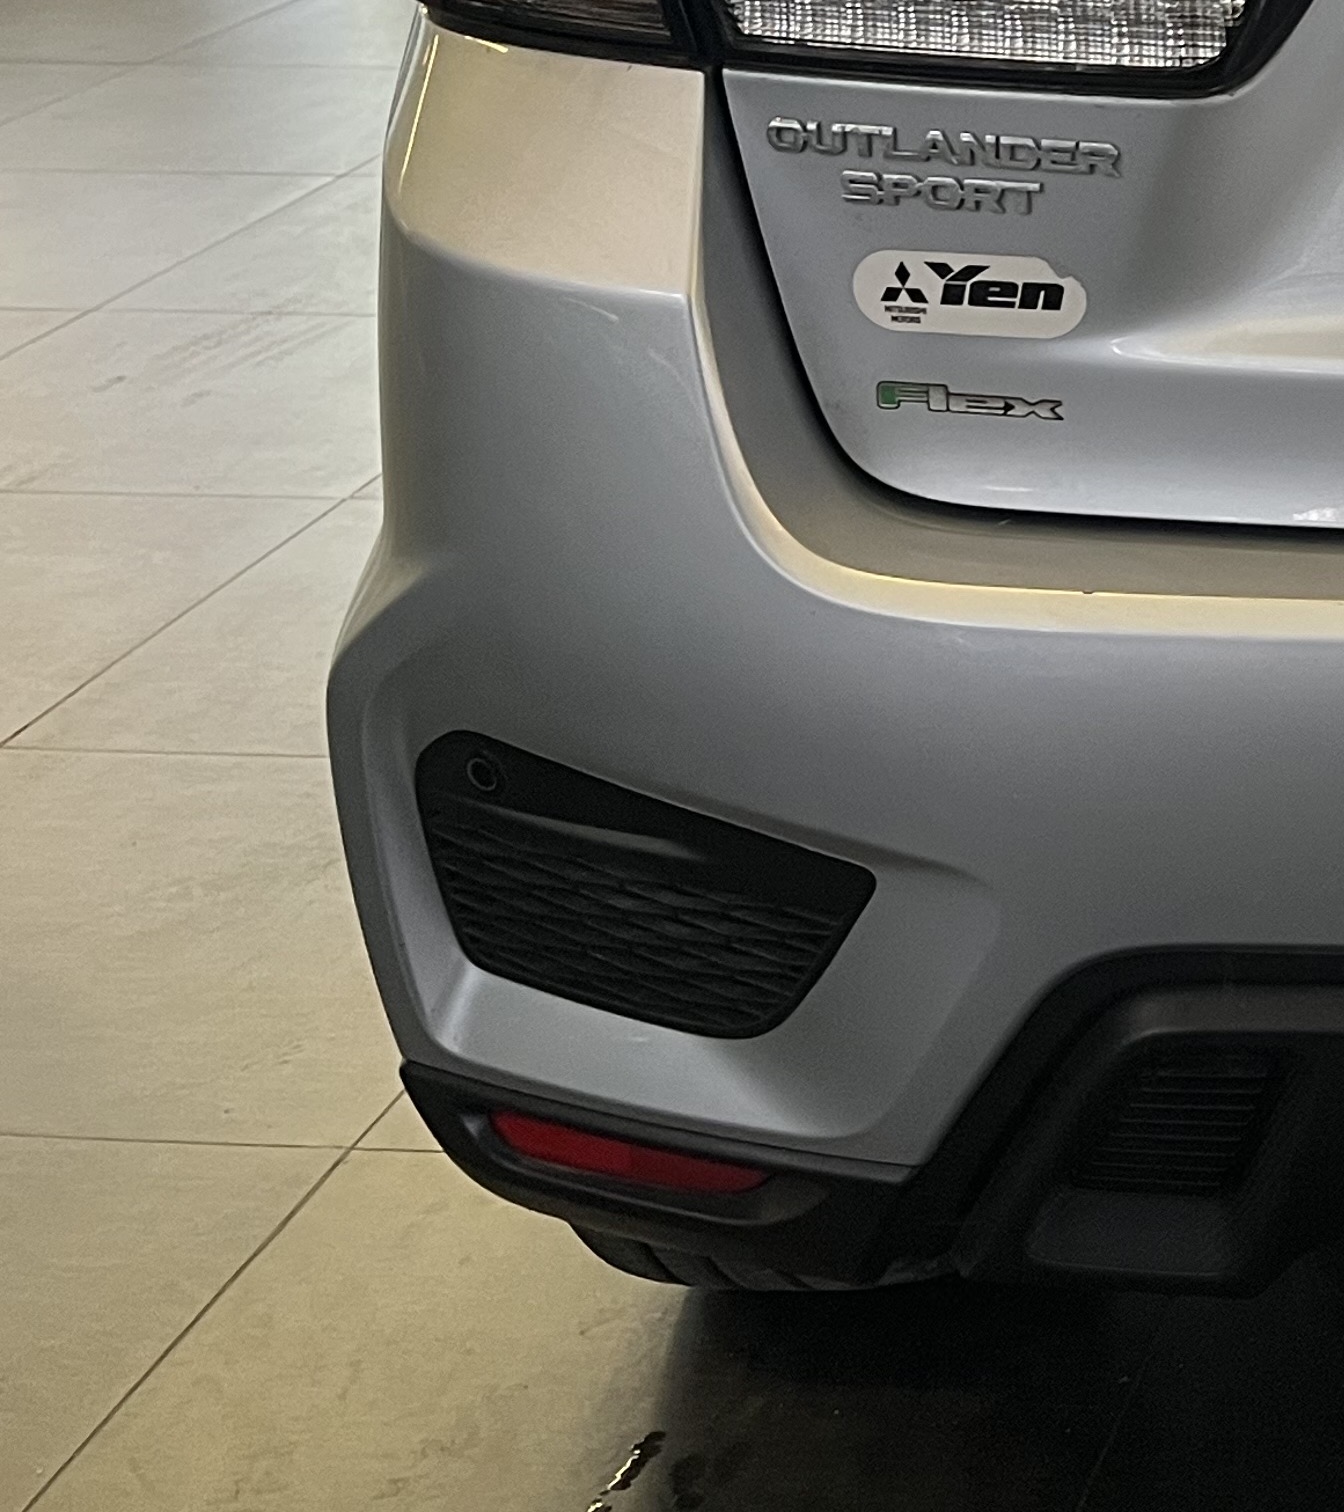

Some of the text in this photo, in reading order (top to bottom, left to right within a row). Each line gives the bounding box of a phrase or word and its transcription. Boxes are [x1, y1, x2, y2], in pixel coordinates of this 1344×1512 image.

[767, 116, 1121, 178] OUTLANDER
[841, 170, 1044, 214] SPORT
[923, 261, 1064, 310] Yen
[877, 381, 1064, 420] Flex
